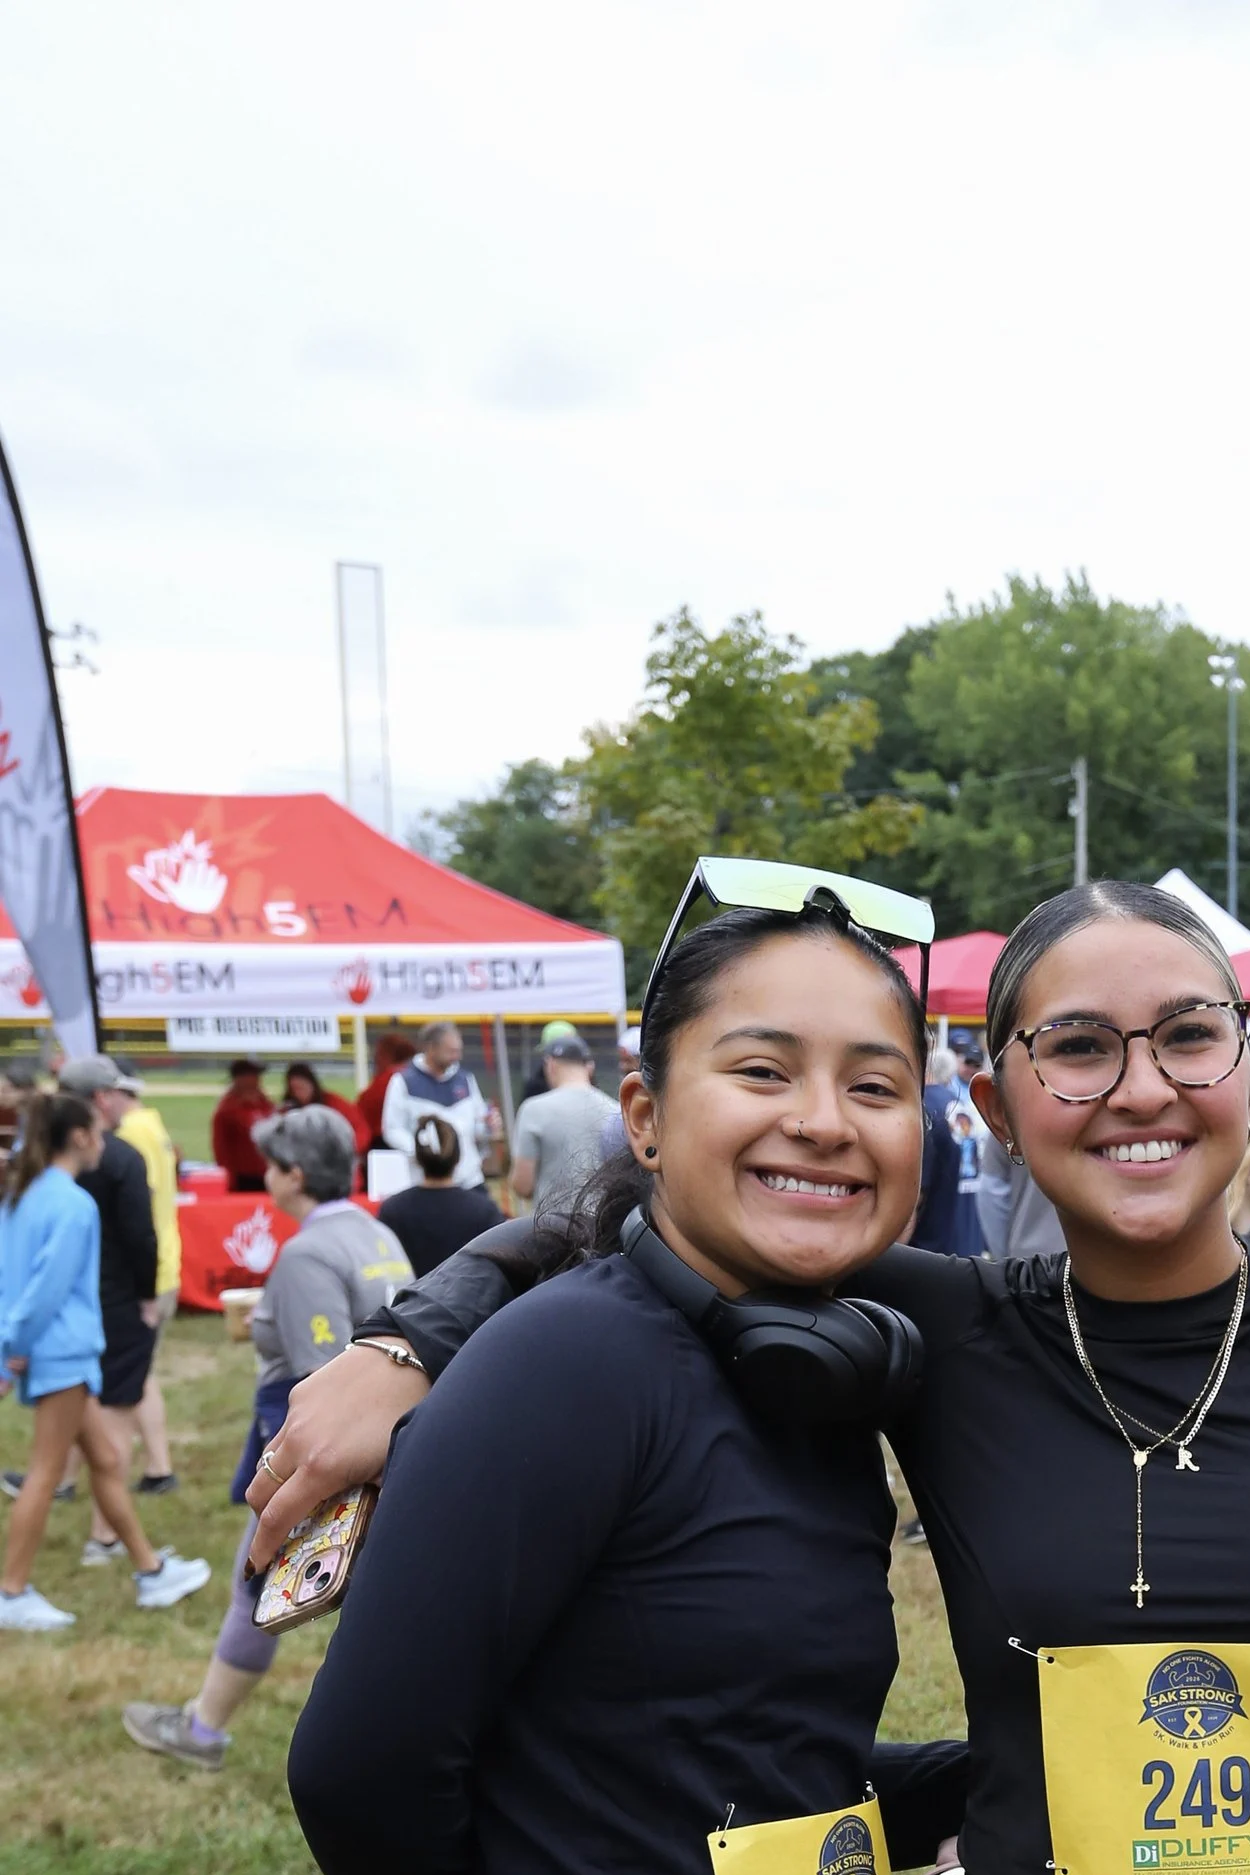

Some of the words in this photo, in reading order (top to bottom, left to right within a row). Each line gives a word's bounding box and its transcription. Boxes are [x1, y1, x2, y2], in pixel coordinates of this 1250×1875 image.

[95, 960, 236, 1003] gh5EM
[378, 957, 546, 1002] High5EM
[1170, 1659, 1182, 1667] ONE
[1203, 1659, 1221, 1672] ALONE
[1149, 1691, 1178, 1708] SAK
[1179, 1688, 1236, 1704] STRONG
[1169, 1738, 1190, 1750] Walk
[1192, 1742, 1199, 1750] &
[1201, 1739, 1218, 1748] Fun
[1219, 1725, 1236, 1740] Run
[843, 1854, 873, 1869] STRONG
[1134, 1844, 1159, 1864] Di
[1162, 1858, 1213, 1868] INSURANCE
